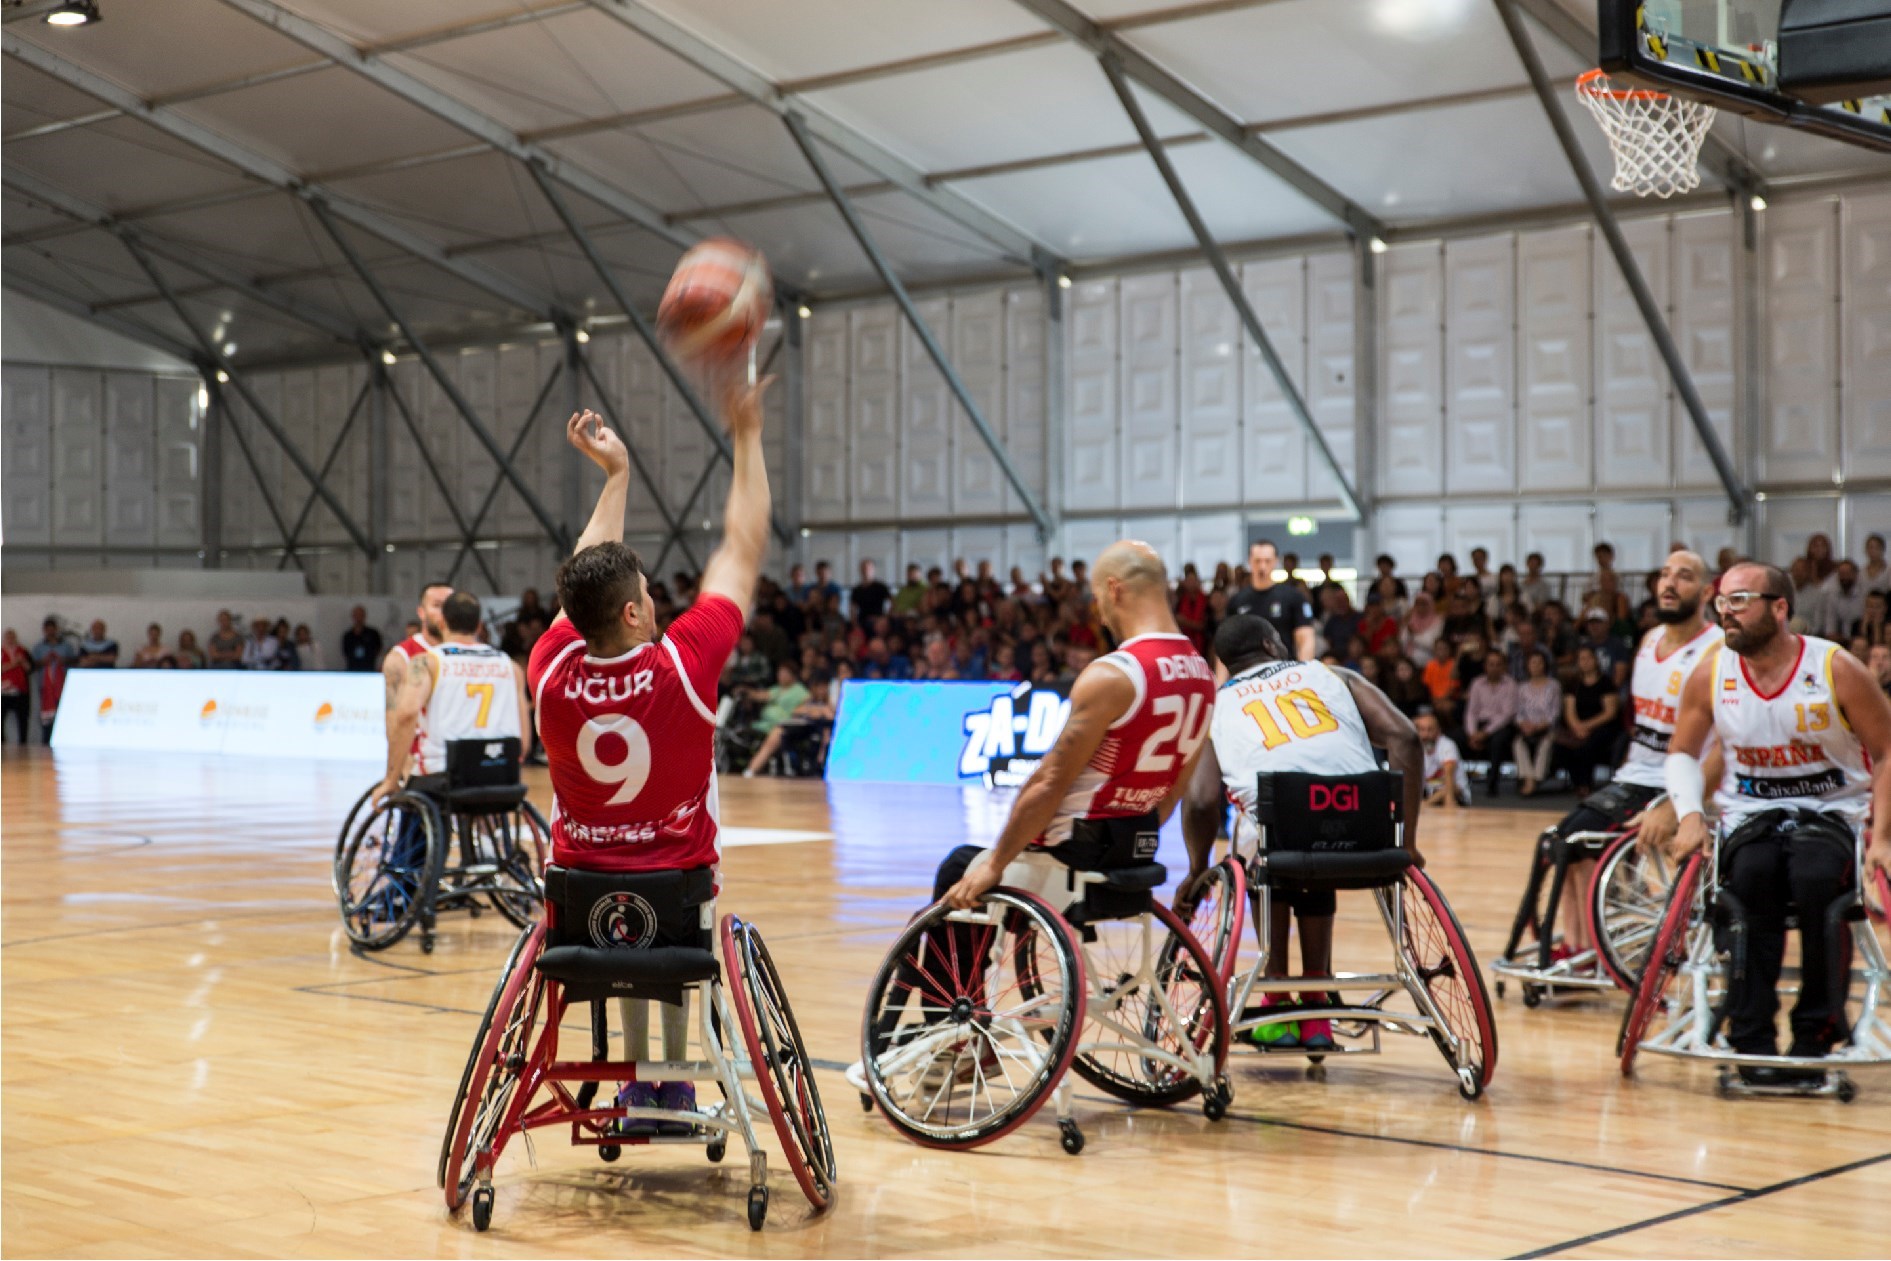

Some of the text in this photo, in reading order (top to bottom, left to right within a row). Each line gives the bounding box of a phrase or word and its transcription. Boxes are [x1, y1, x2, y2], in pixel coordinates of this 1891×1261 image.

[466, 684, 494, 729] 7
[565, 669, 654, 704] UĞUR
[1135, 693, 1214, 773] 24
[1242, 688, 1339, 752] 10
[1795, 703, 1830, 732] 13
[576, 713, 652, 807] 9
[1309, 784, 1360, 812] DGI
[1755, 776, 1837, 797] CaixaBank
